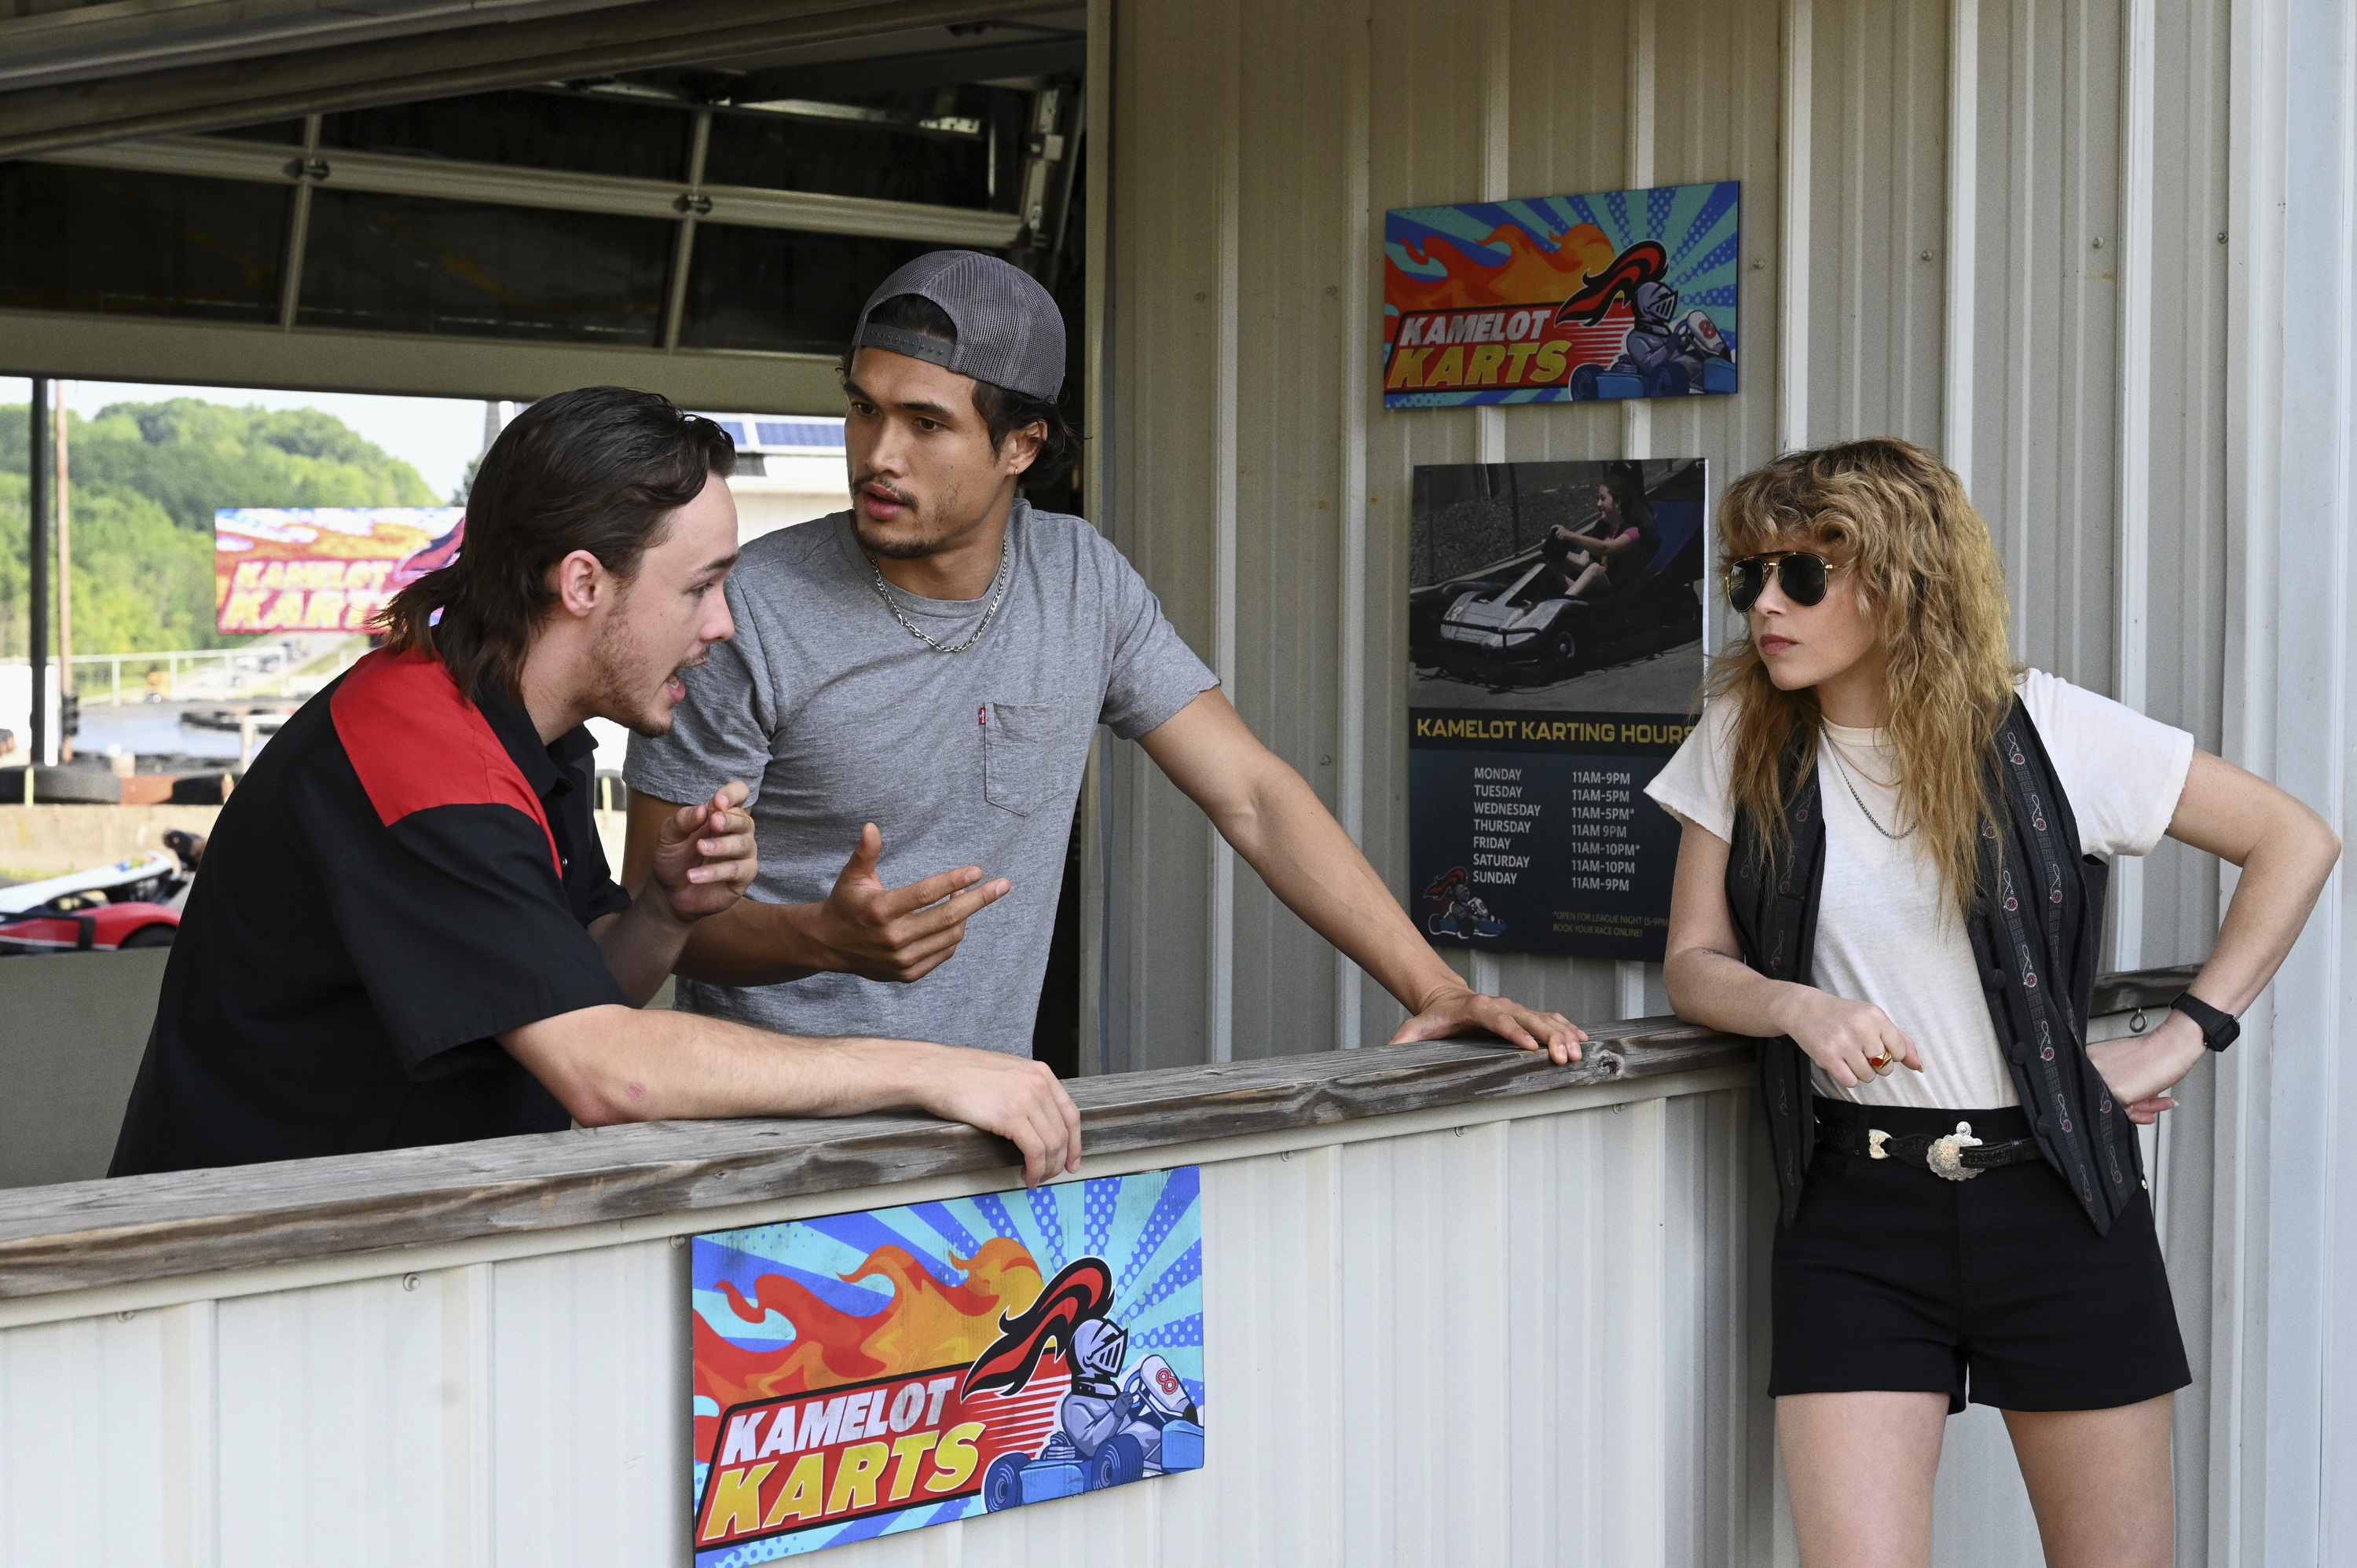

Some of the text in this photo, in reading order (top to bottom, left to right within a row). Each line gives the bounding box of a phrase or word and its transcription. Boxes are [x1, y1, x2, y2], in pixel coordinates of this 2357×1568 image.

[1398, 310, 1551, 346] KAMELOT
[1699, 320, 1716, 339] 8
[1387, 340, 1572, 388] KARTS
[1417, 718, 1516, 739] KAMELOT
[1521, 721, 1615, 742] KARTING
[1474, 767, 1522, 781] MONDAY
[1572, 771, 1630, 786] 11AM-9PM
[1474, 784, 1523, 798] TUESDAY
[1572, 789, 1629, 803] 11AM-5PM
[1474, 801, 1541, 817] WEDNESDAY
[1473, 819, 1531, 833] THURSDAY
[1473, 836, 1512, 850] FRIDAY
[1473, 853, 1530, 868] SATURDAY
[1571, 859, 1635, 874] 11AM-10PM
[1473, 870, 1518, 885] SUNDAY
[1571, 877, 1629, 892] 11AM-9PM
[1577, 912, 1591, 921] FOR
[1592, 914, 1618, 924] LEAGUE
[1620, 915, 1642, 925] NIGHT
[1552, 923, 1643, 937] BOOK YOUR RACE ONLINE!
[1156, 1368, 1178, 1394] 8
[720, 1376, 955, 1467] KAMELOT
[702, 1421, 986, 1541] KARTS
